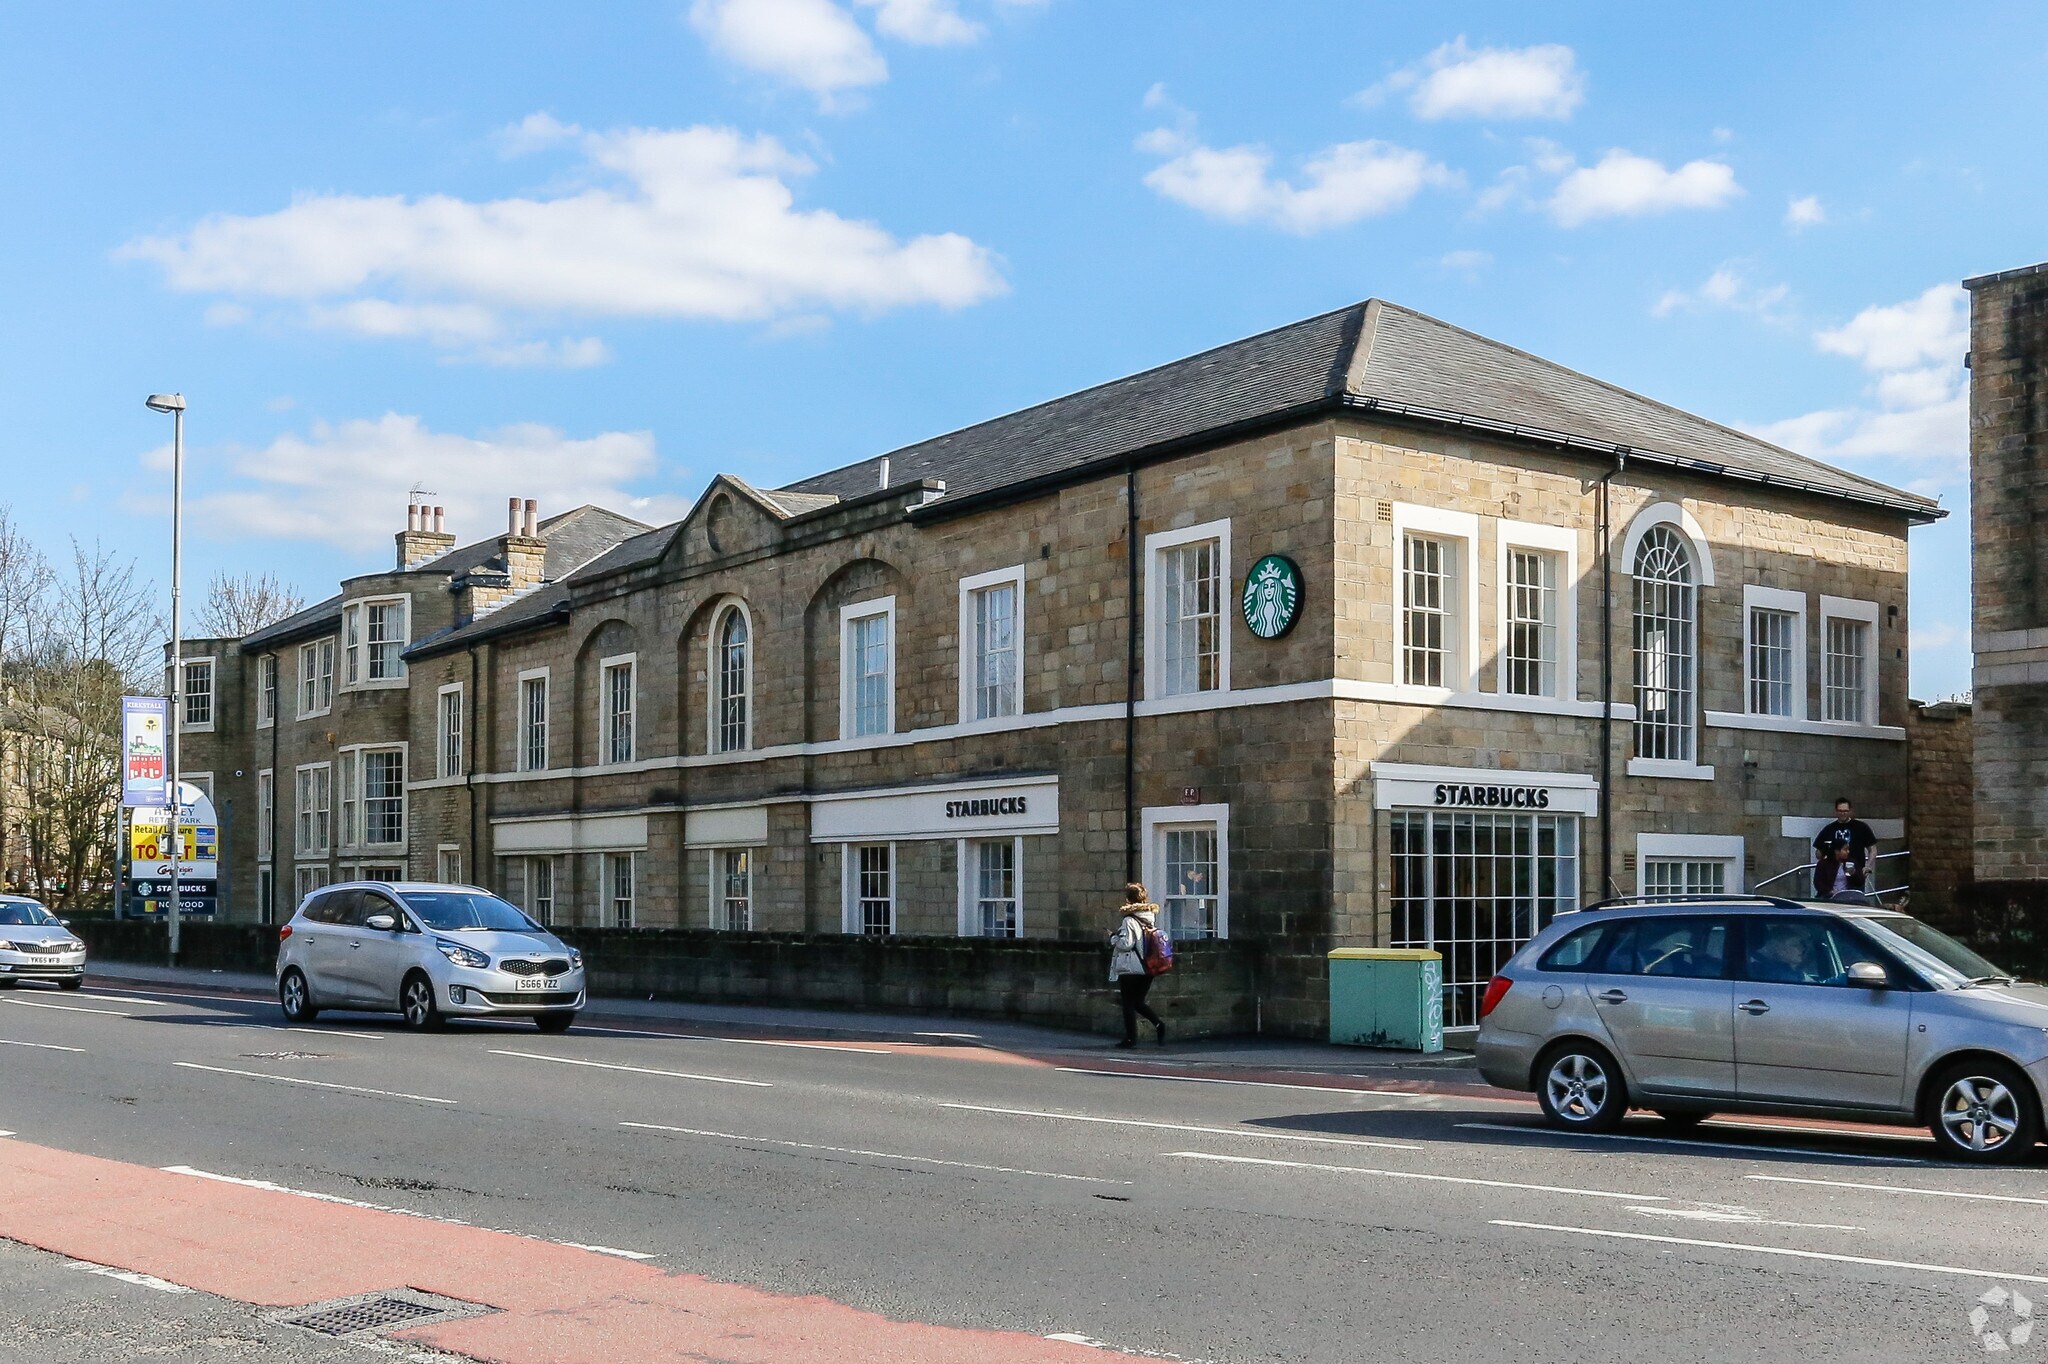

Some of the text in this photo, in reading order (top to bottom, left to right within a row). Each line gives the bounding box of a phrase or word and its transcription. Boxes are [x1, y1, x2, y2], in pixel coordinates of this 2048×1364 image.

[1435, 784, 1549, 808] STARBUCKS
[154, 807, 195, 817] ABEY
[946, 797, 1026, 818] STARBUCKS
[135, 845, 157, 859] TO
[521, 980, 558, 988] SG66 VZZ
